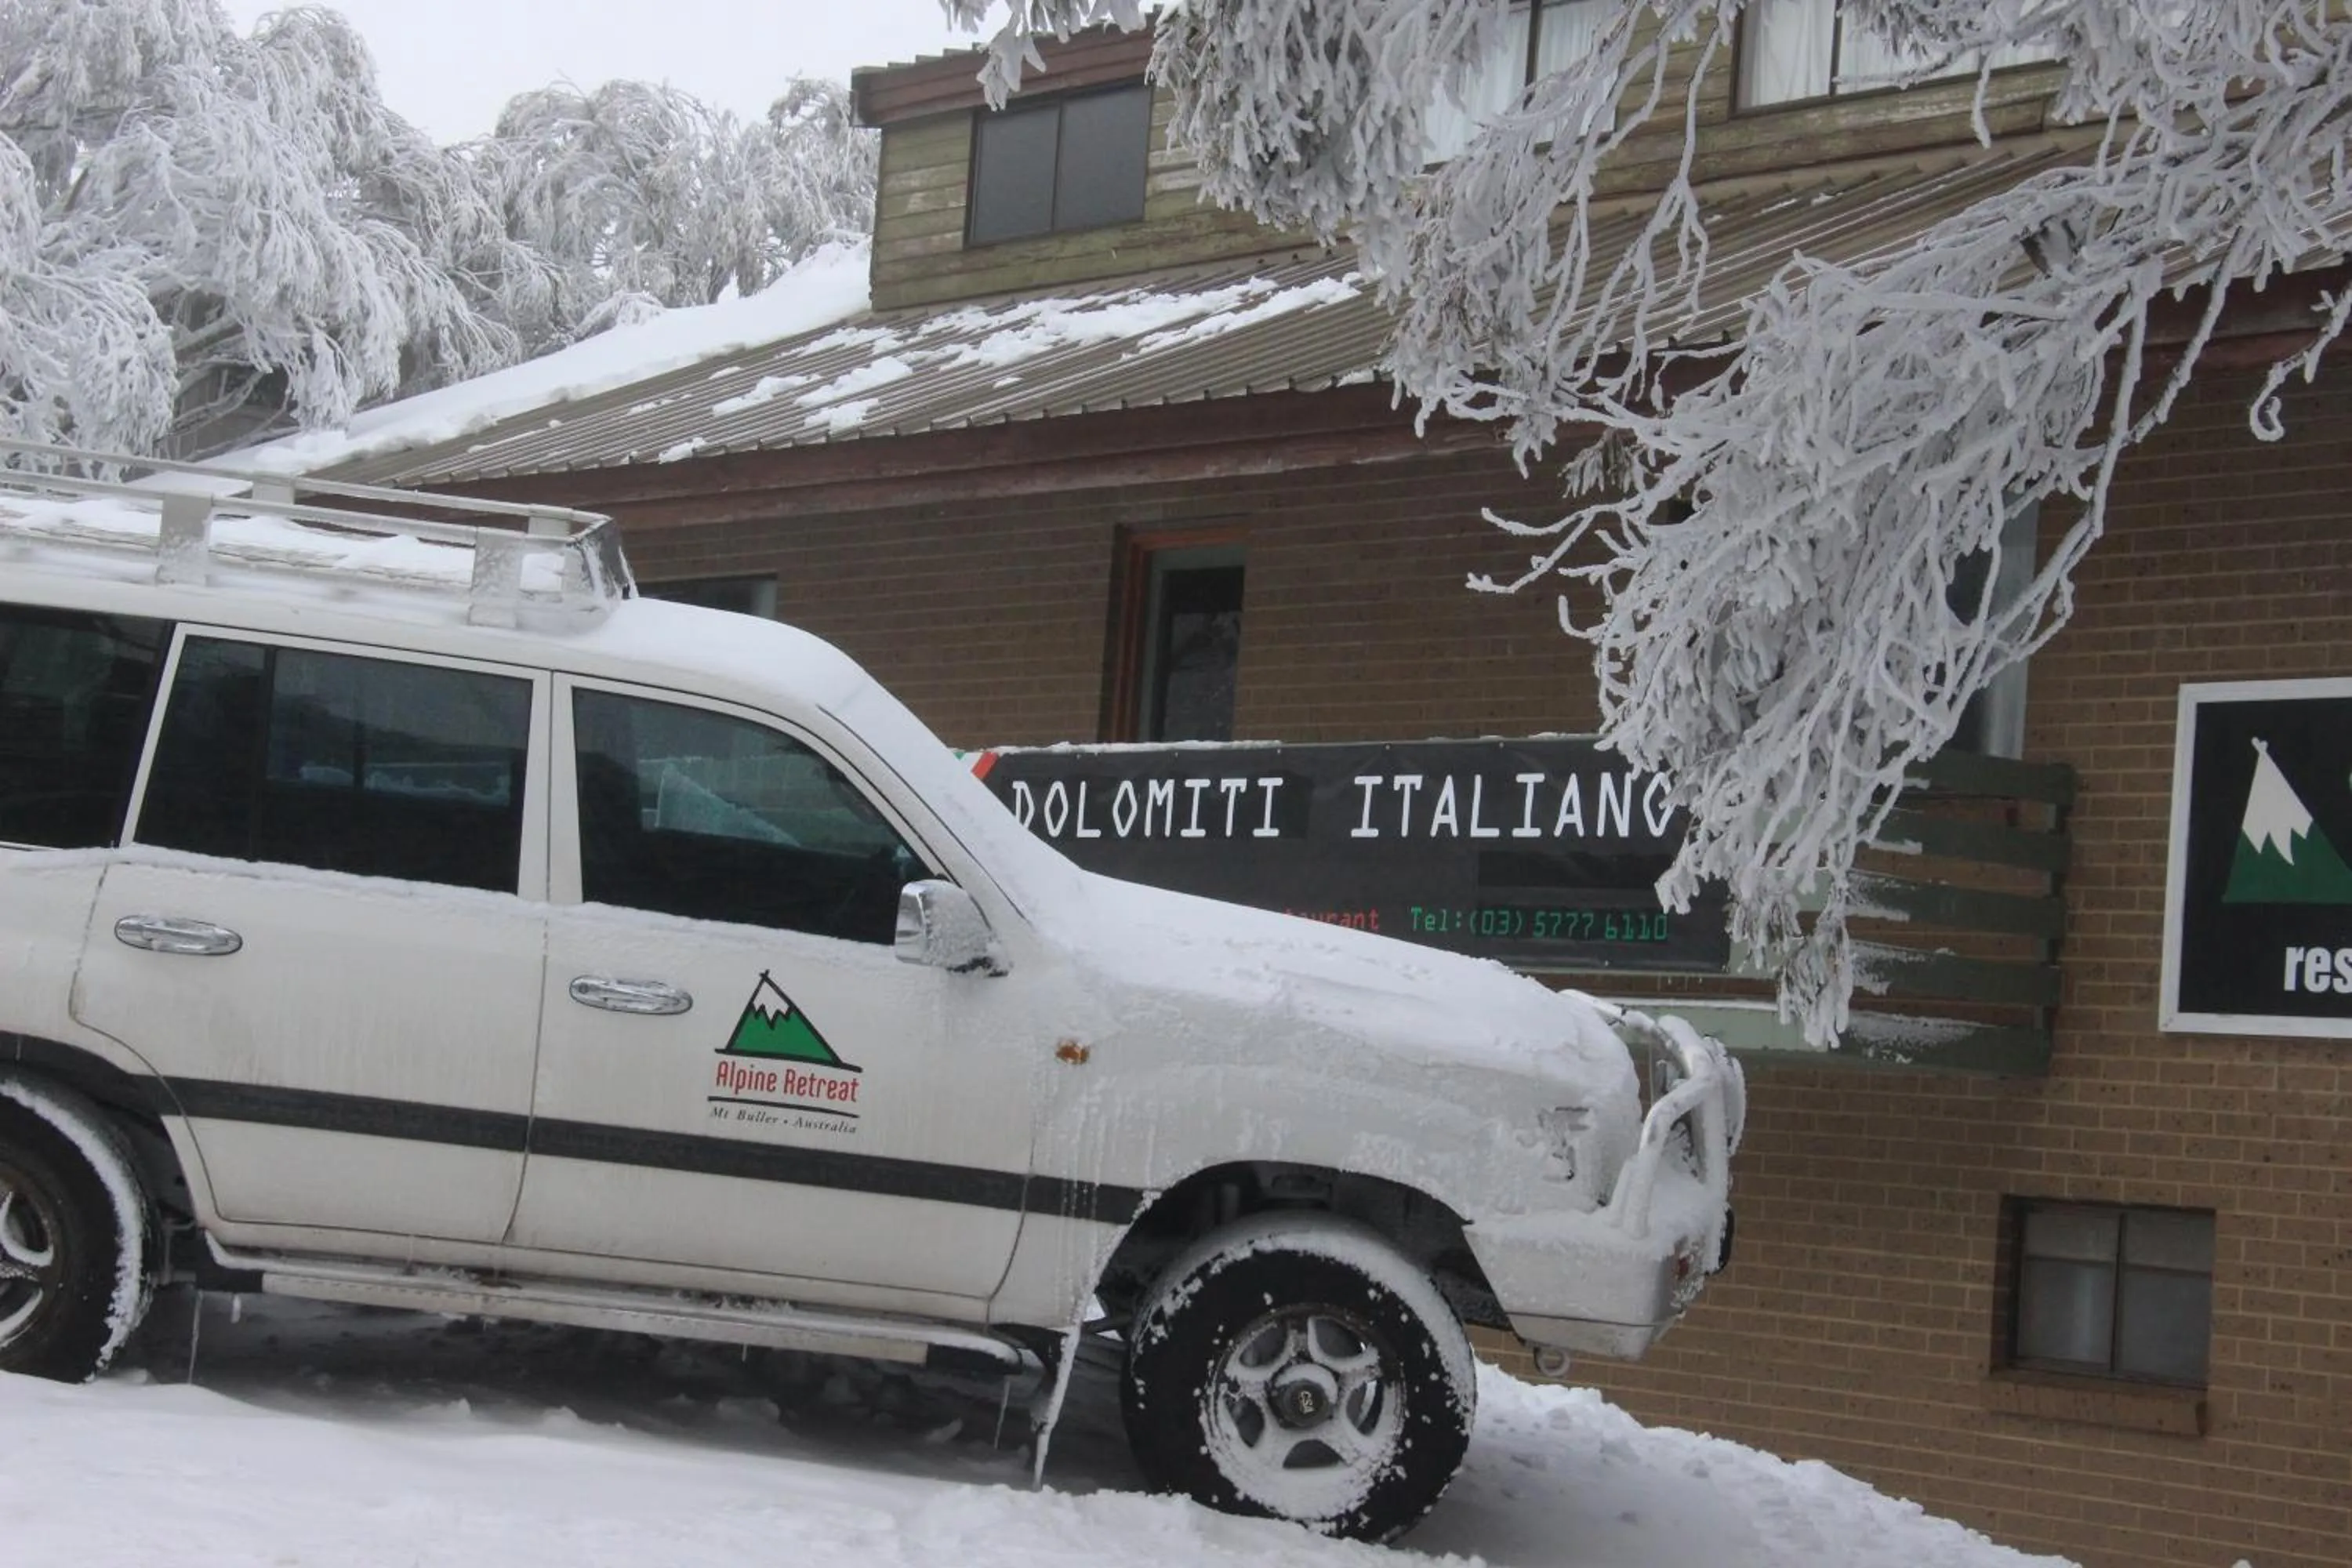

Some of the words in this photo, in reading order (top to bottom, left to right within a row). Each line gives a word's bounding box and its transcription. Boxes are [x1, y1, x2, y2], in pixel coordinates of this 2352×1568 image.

[1012, 777, 1283, 838] DOLOMITI
[1351, 771, 1675, 837] ITALIANO
[1533, 910, 1594, 938] 5777
[1605, 913, 1668, 940] 6110
[2284, 946, 2352, 994] res
[716, 1061, 777, 1094] Alpine
[783, 1069, 859, 1102] Retreat
[710, 1106, 728, 1119] Mt
[737, 1110, 778, 1123] Buller
[793, 1116, 857, 1134] Australia
